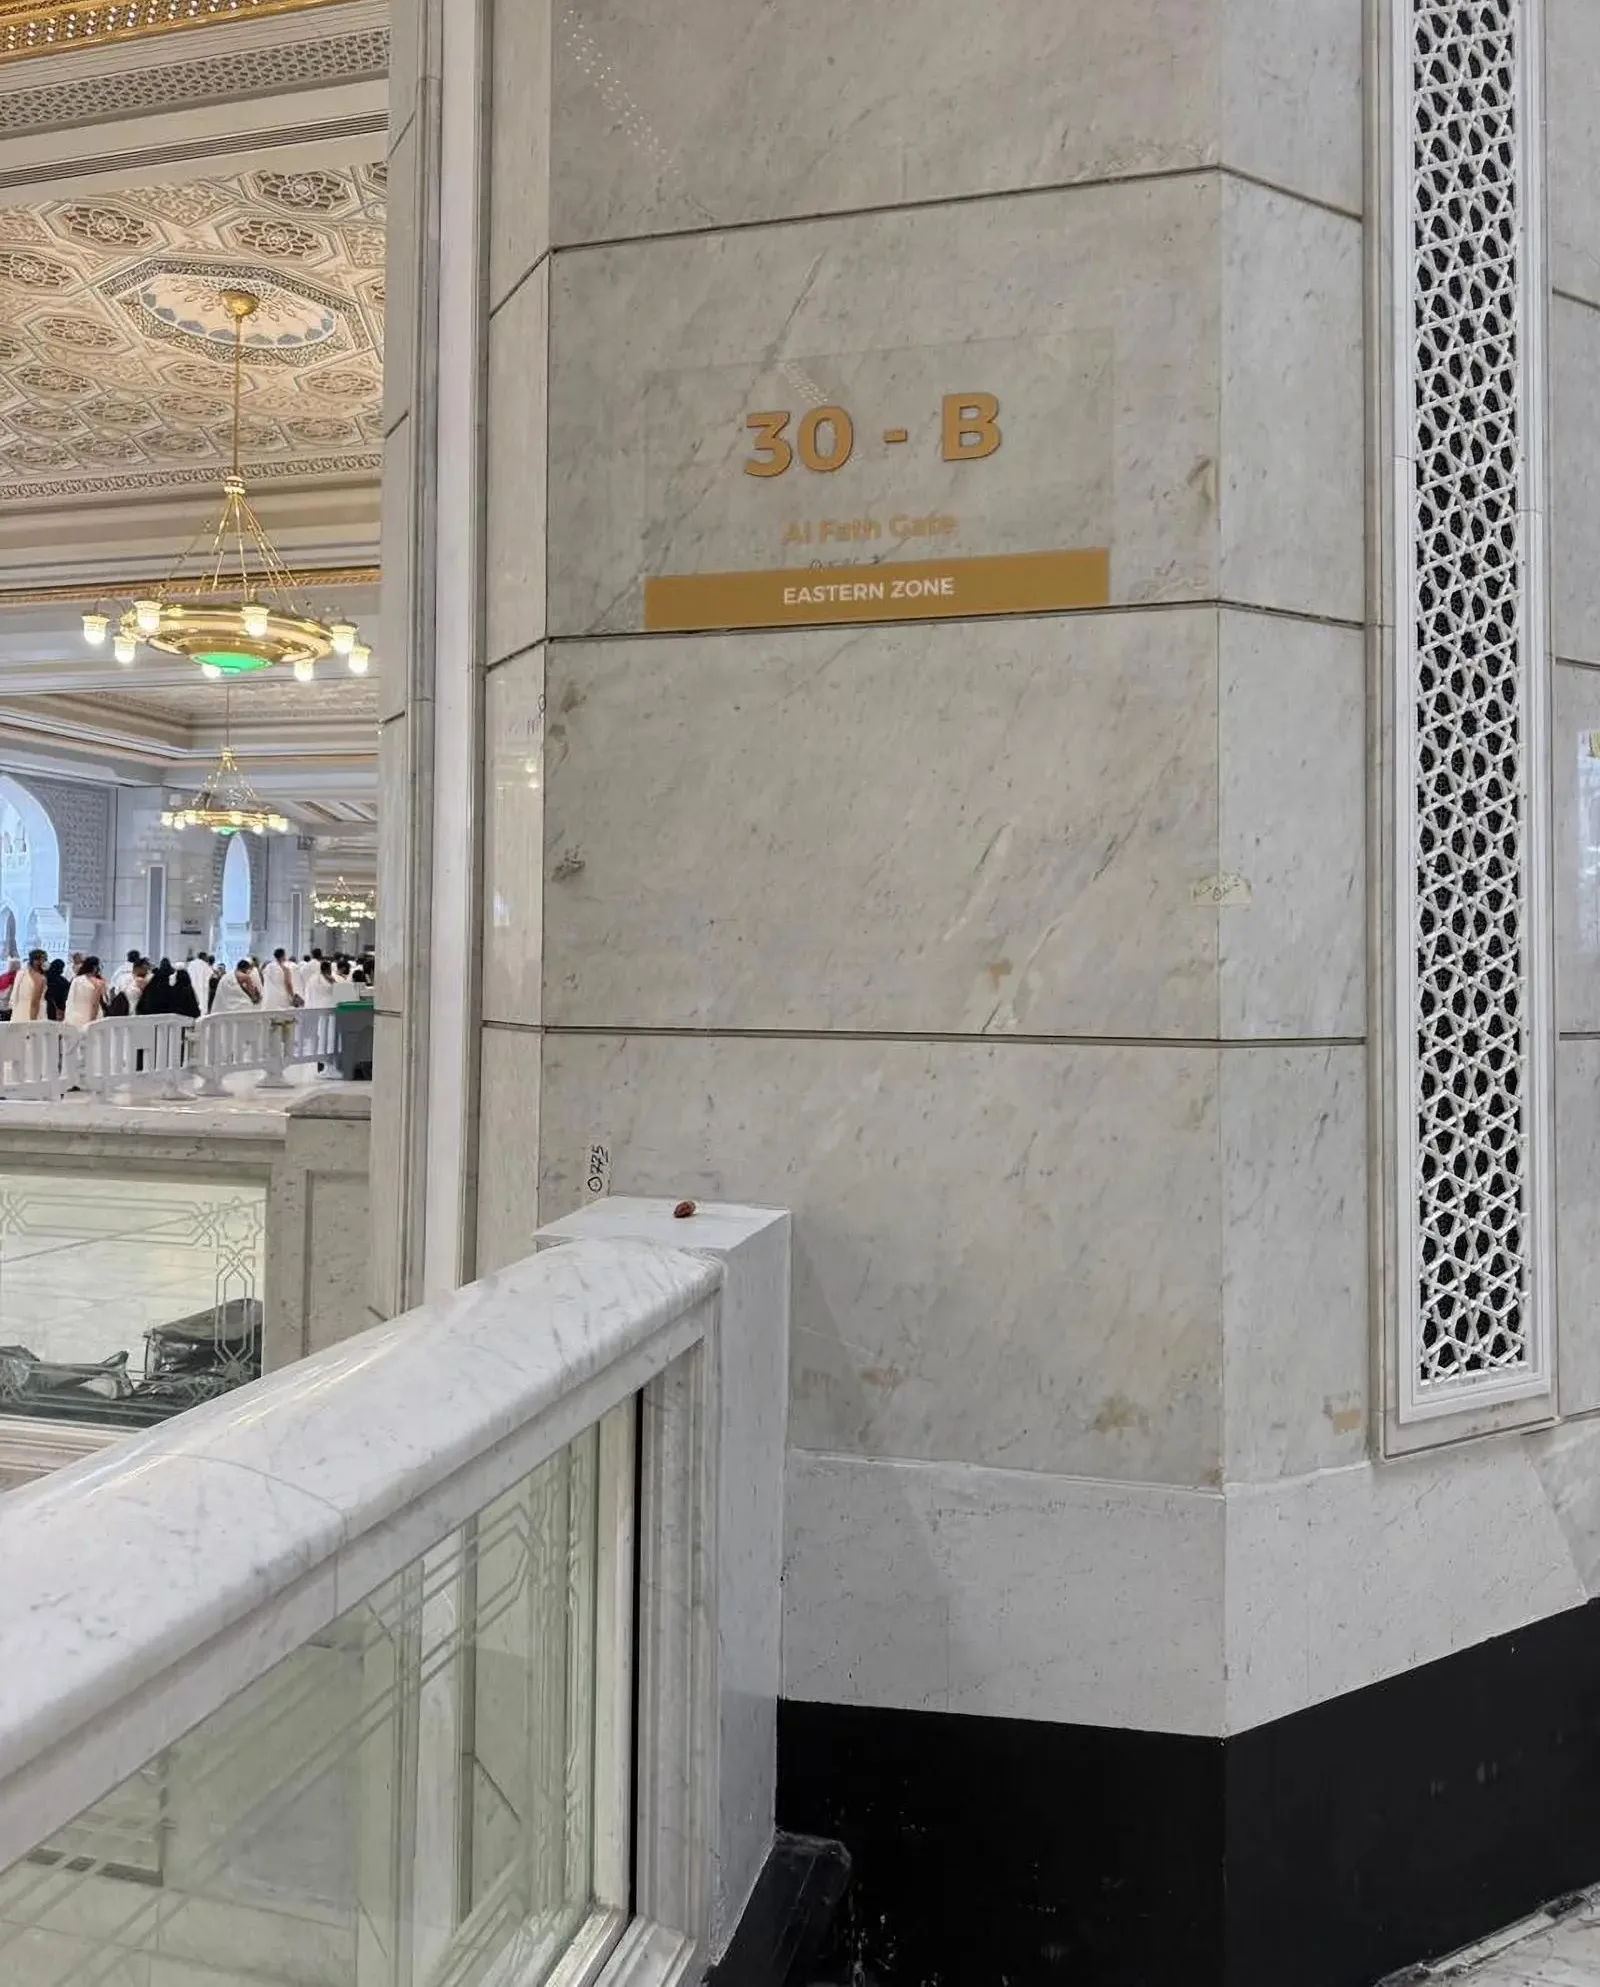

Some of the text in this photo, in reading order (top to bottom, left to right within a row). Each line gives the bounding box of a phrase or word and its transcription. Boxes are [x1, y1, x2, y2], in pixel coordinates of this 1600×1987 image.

[744, 405, 855, 478] 30
[941, 391, 1003, 463] B
[889, 513, 959, 539] Gate
[783, 577, 956, 606] EASTERN ZONE
